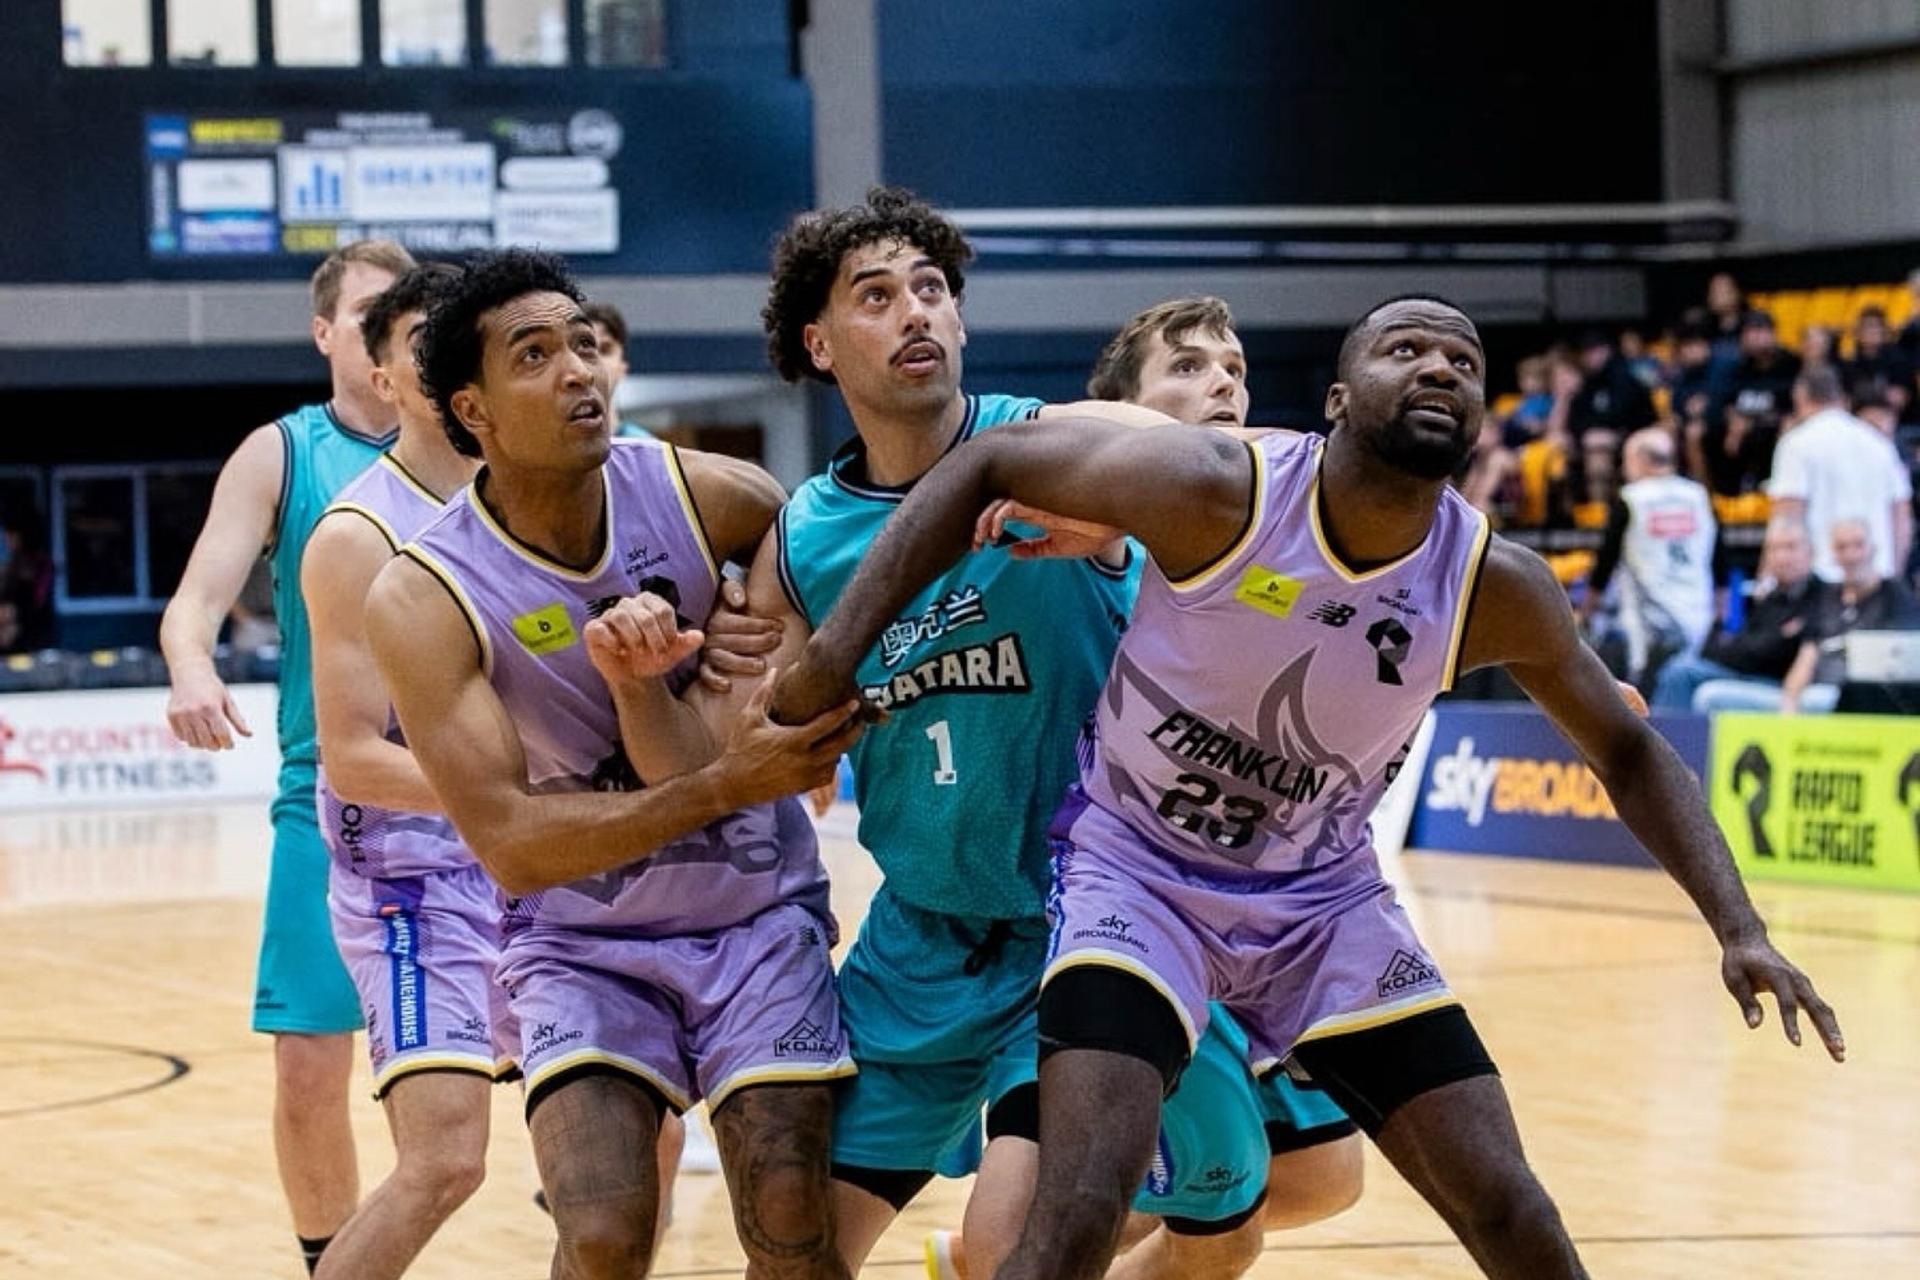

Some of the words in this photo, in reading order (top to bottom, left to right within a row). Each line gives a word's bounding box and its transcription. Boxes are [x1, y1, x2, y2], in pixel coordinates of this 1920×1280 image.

[23, 726, 184, 755] COUNTI
[925, 719, 957, 785] 1
[1149, 709, 1329, 804] FRANKLIN
[57, 758, 216, 789] FITNESS
[1794, 770, 1862, 813] RAPID
[1156, 773, 1267, 848] 23
[1788, 821, 1875, 867] LEAGUE
[1096, 914, 1134, 933] sky
